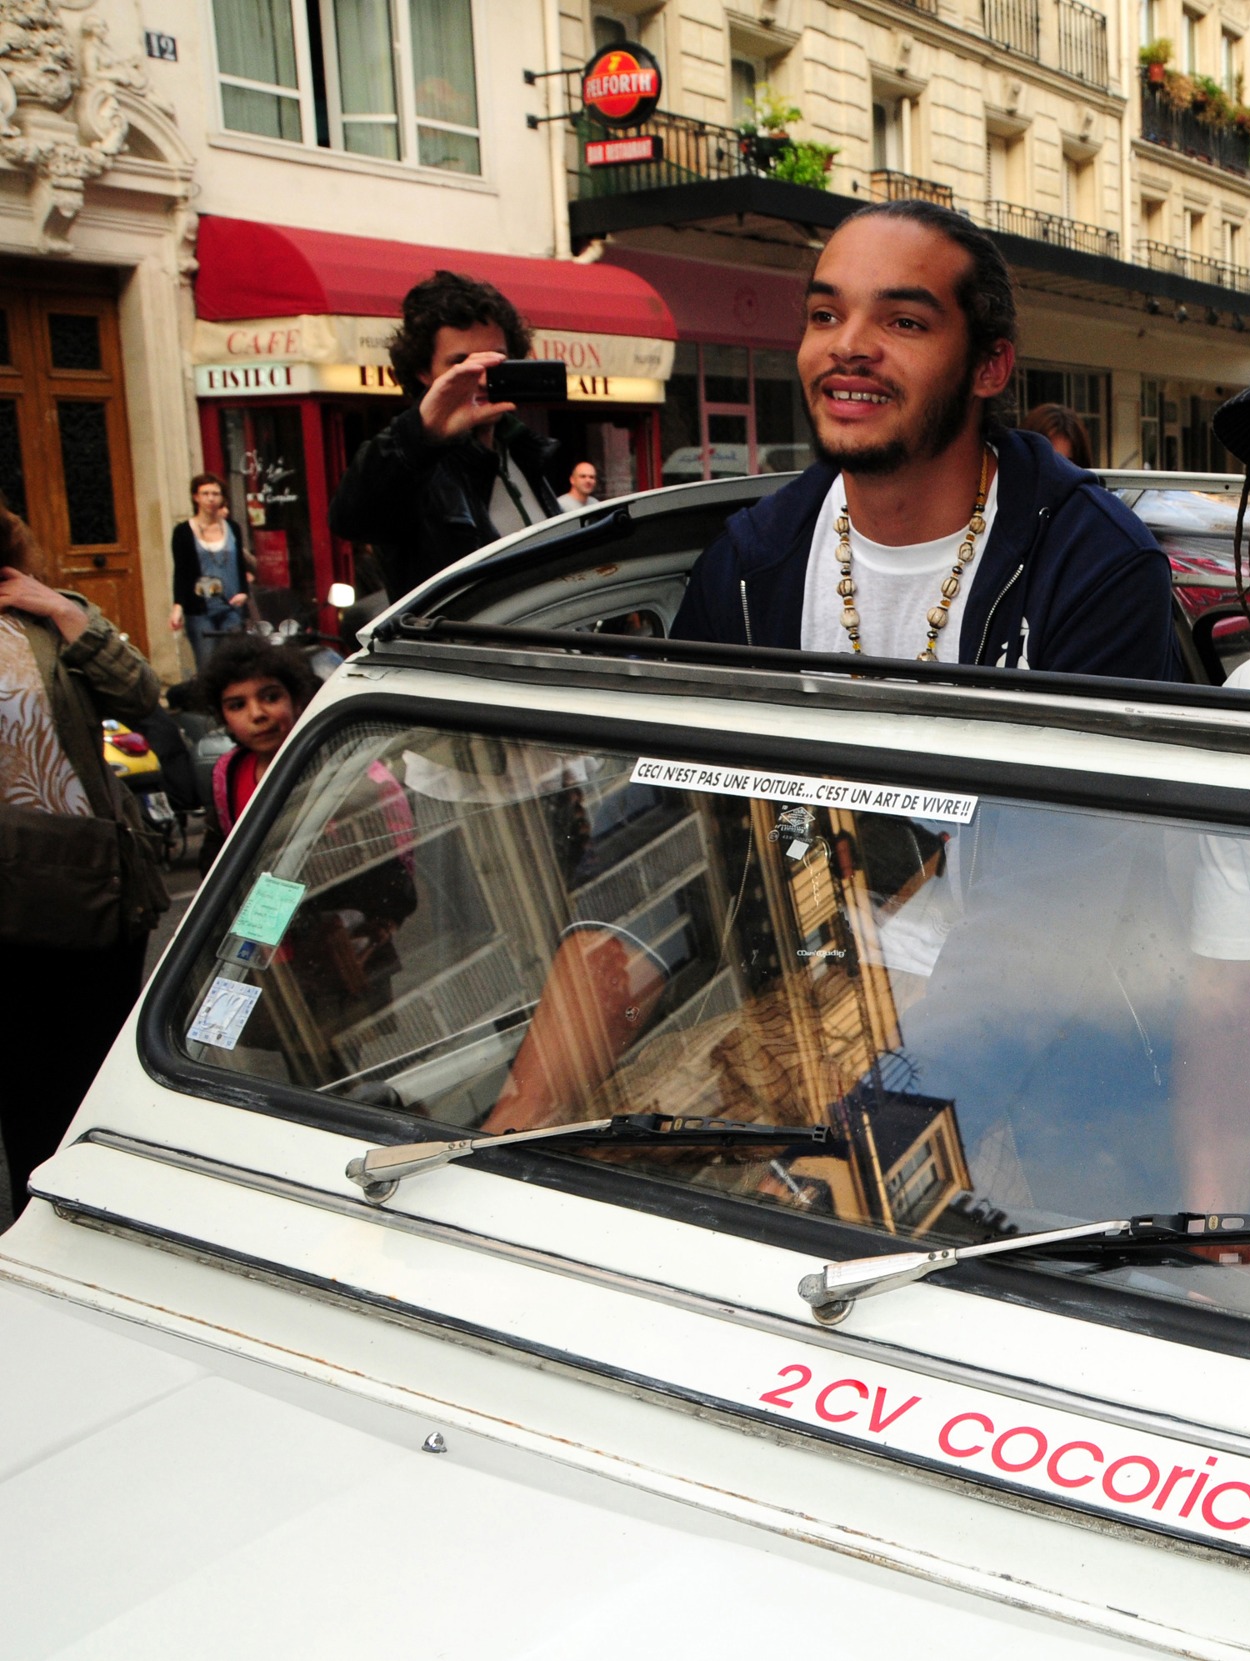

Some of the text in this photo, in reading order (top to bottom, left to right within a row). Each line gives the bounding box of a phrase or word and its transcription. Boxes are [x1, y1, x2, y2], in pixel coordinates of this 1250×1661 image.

[586, 73, 652, 99] PELFORTH
[208, 366, 292, 389] BISTROT
[637, 763, 663, 779] CECI
[663, 766, 697, 783] N'EST
[697, 771, 722, 787] PAS
[723, 774, 750, 790] UNE
[816, 784, 849, 801] C'EST
[850, 789, 873, 805] UN
[872, 792, 900, 809] ART
[901, 795, 920, 811] DE
